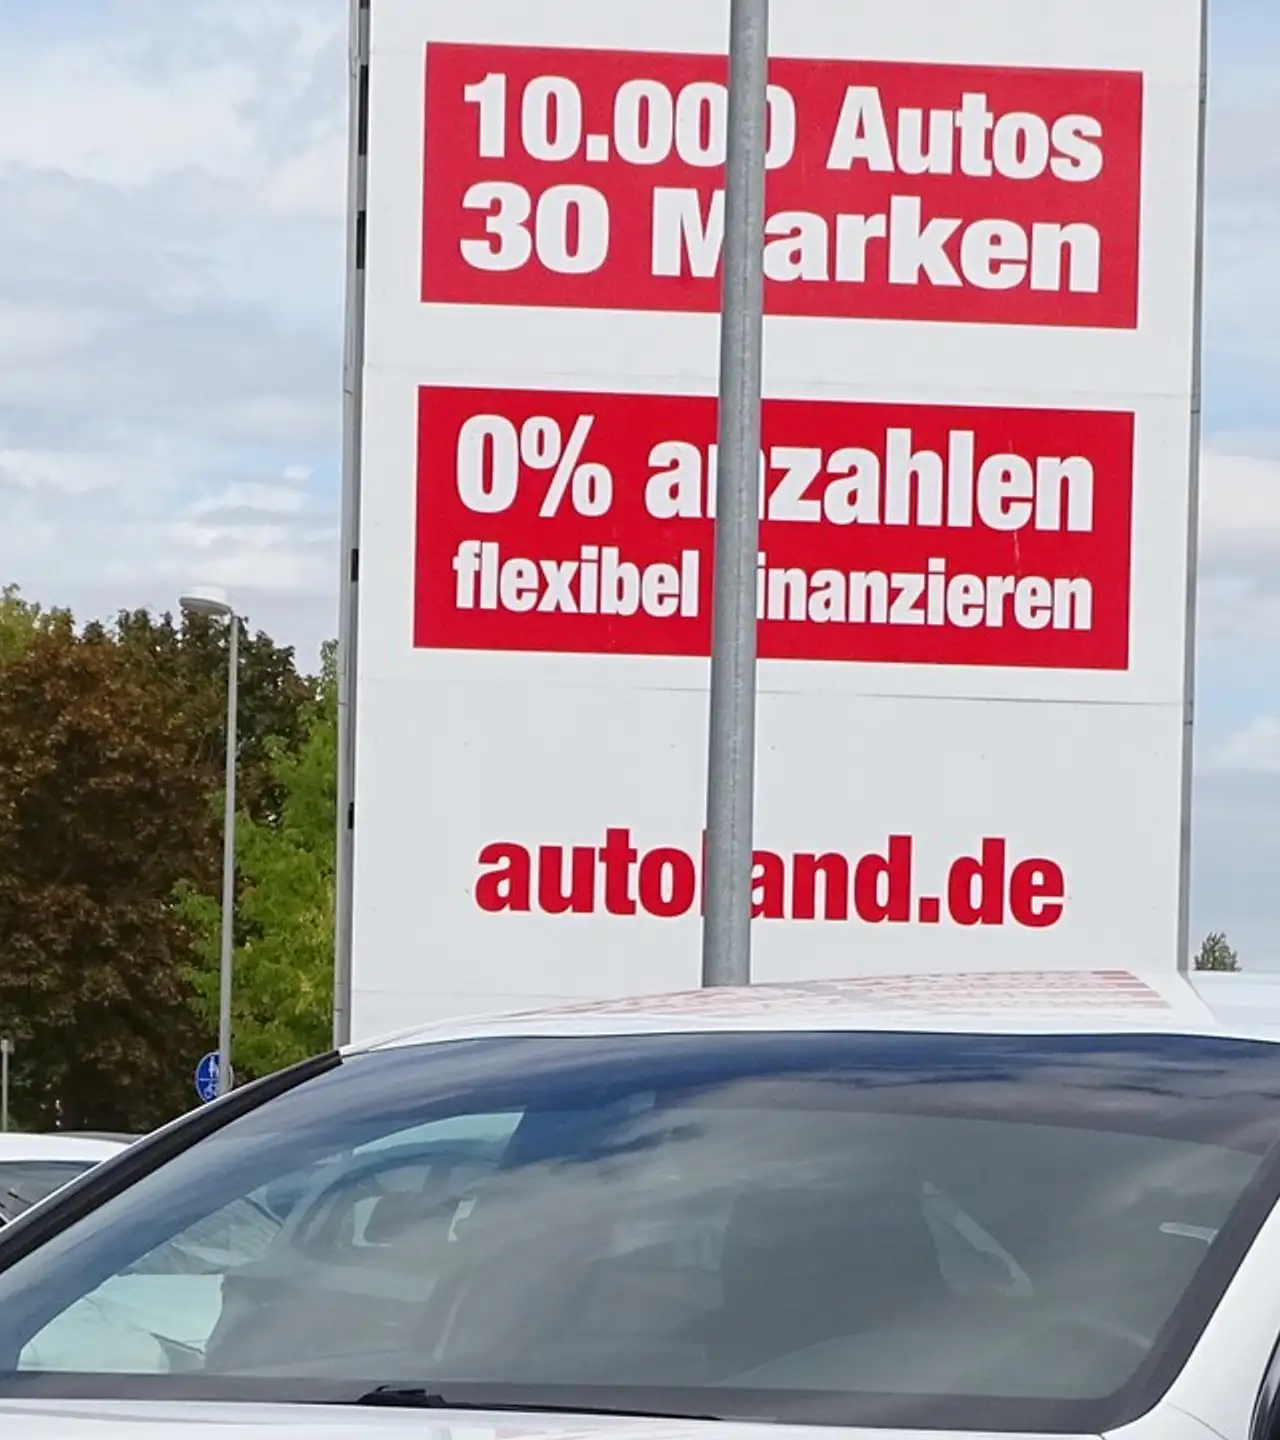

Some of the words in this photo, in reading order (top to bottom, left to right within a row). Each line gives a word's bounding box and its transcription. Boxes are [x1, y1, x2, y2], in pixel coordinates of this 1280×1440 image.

[827, 85, 1104, 183] Autos
[459, 180, 610, 274] 30
[651, 187, 1101, 294] Marken
[456, 413, 613, 519] 0%
[644, 428, 1095, 533] azahlen
[453, 540, 700, 620] flexibel
[756, 551, 1093, 632] inanzieren
[475, 827, 1066, 928] autoand.de
